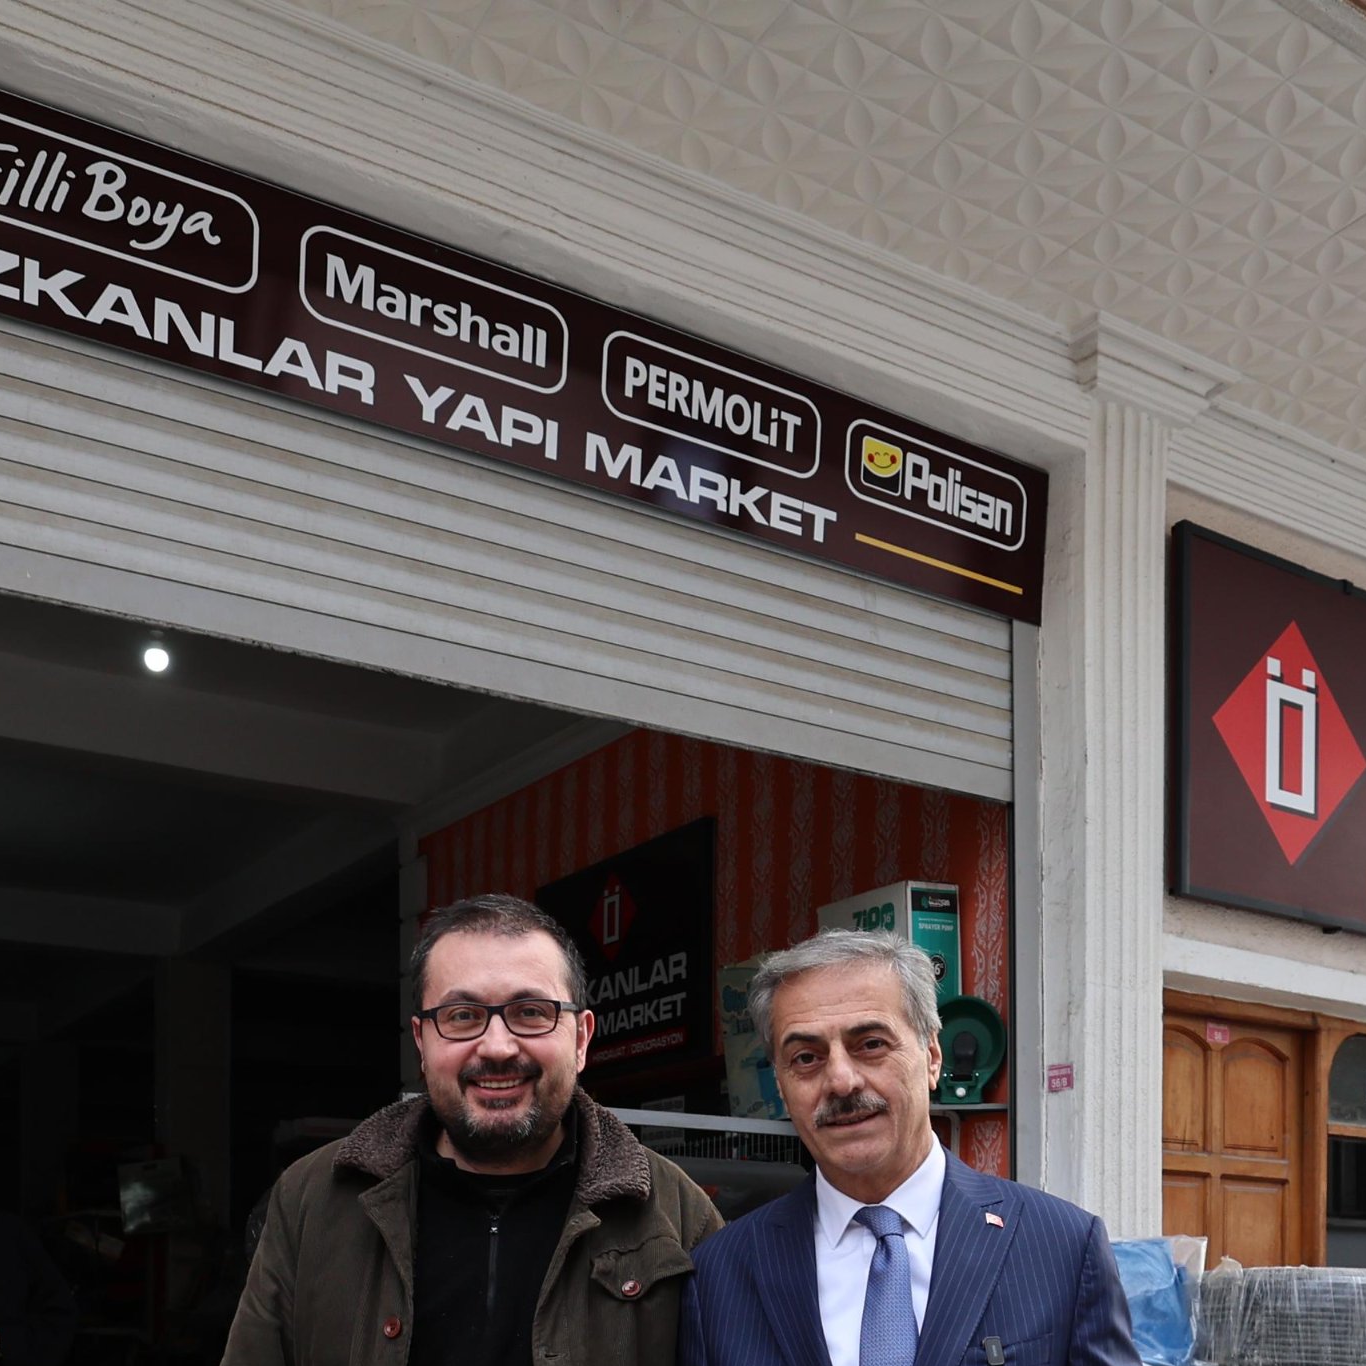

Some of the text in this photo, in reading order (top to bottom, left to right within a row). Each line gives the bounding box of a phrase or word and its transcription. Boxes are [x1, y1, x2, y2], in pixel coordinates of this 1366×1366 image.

[77, 160, 222, 251] Boya
[324, 253, 547, 368] Marshall
[403, 373, 559, 461] YAPI
[584, 431, 838, 544] MARKET
[903, 450, 1013, 537] Polisan
[597, 991, 688, 1038] MARKET
